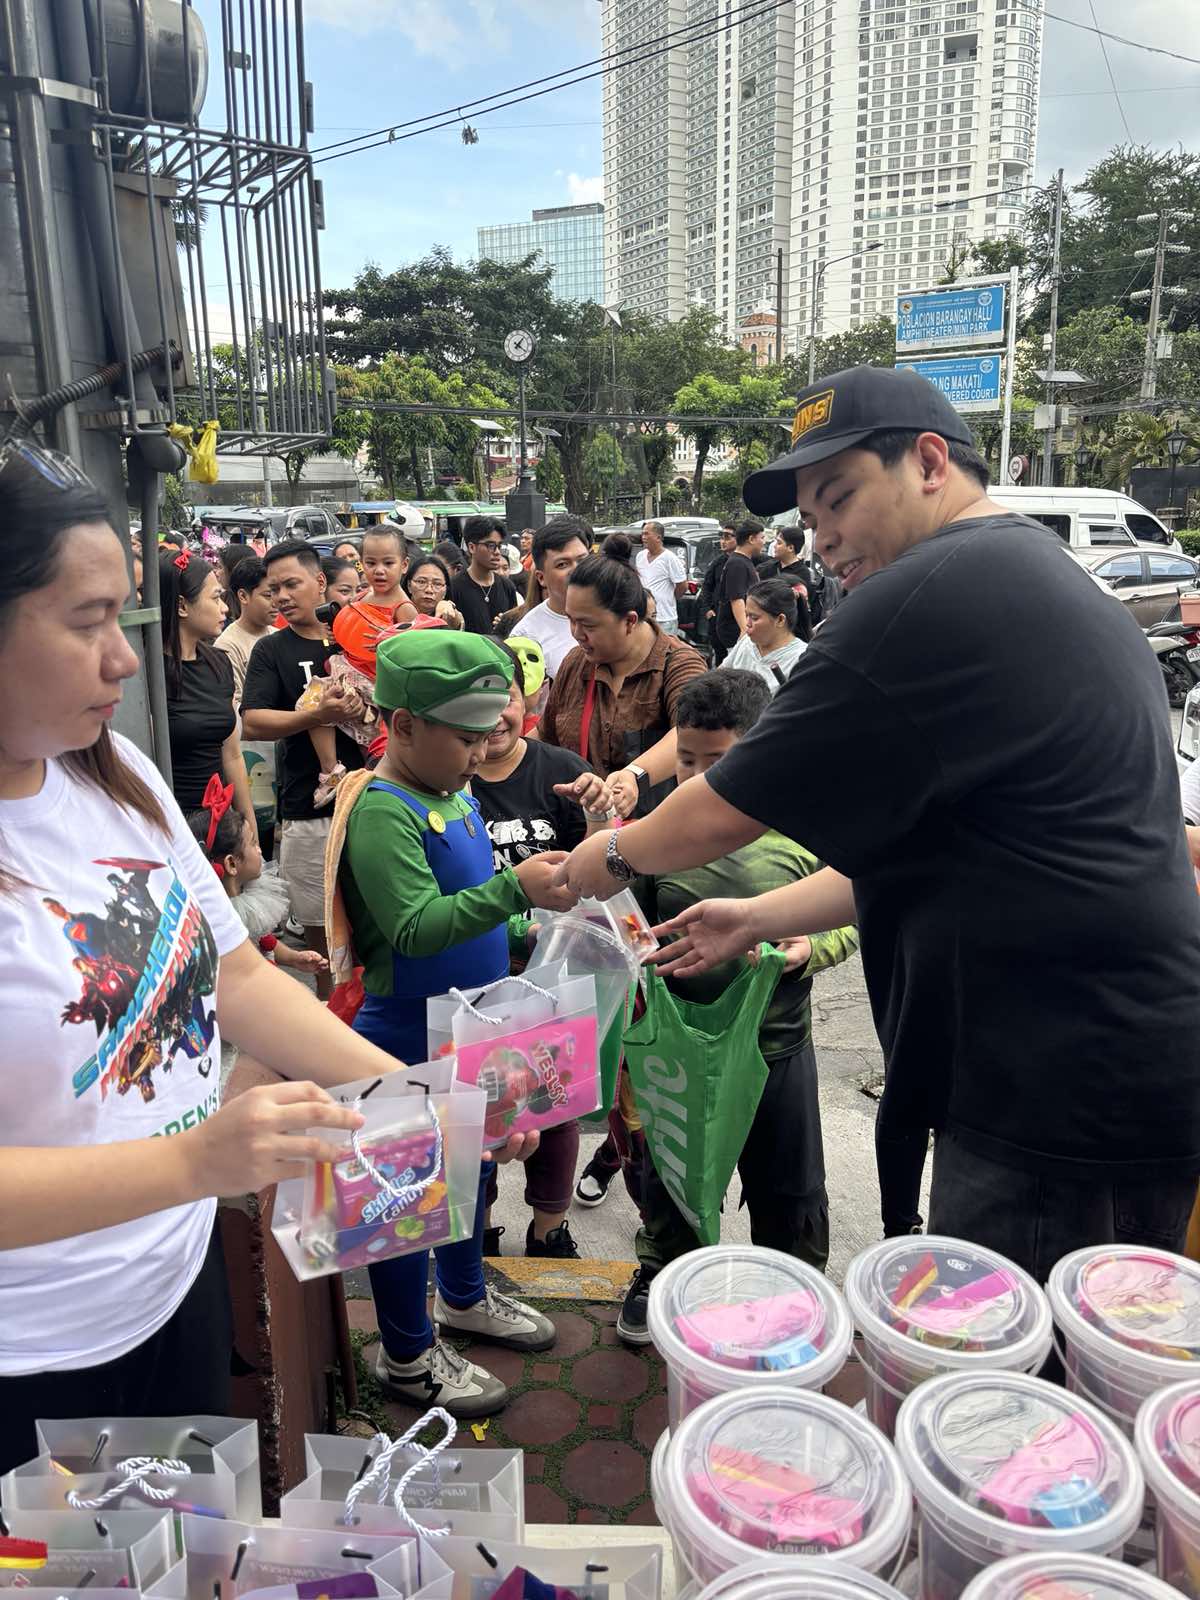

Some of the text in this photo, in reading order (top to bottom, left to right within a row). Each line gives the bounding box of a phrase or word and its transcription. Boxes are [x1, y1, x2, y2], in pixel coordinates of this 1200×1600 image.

[898, 311, 934, 329] POBLACION
[936, 309, 971, 326] BARANGAY
[970, 321, 988, 334] PARK
[939, 376, 950, 391] NG
[944, 388, 995, 401] OVERED COURT
[151, 1087, 218, 1137] REN'S
[637, 1055, 702, 1228] prite
[361, 1167, 416, 1224] Skiles
